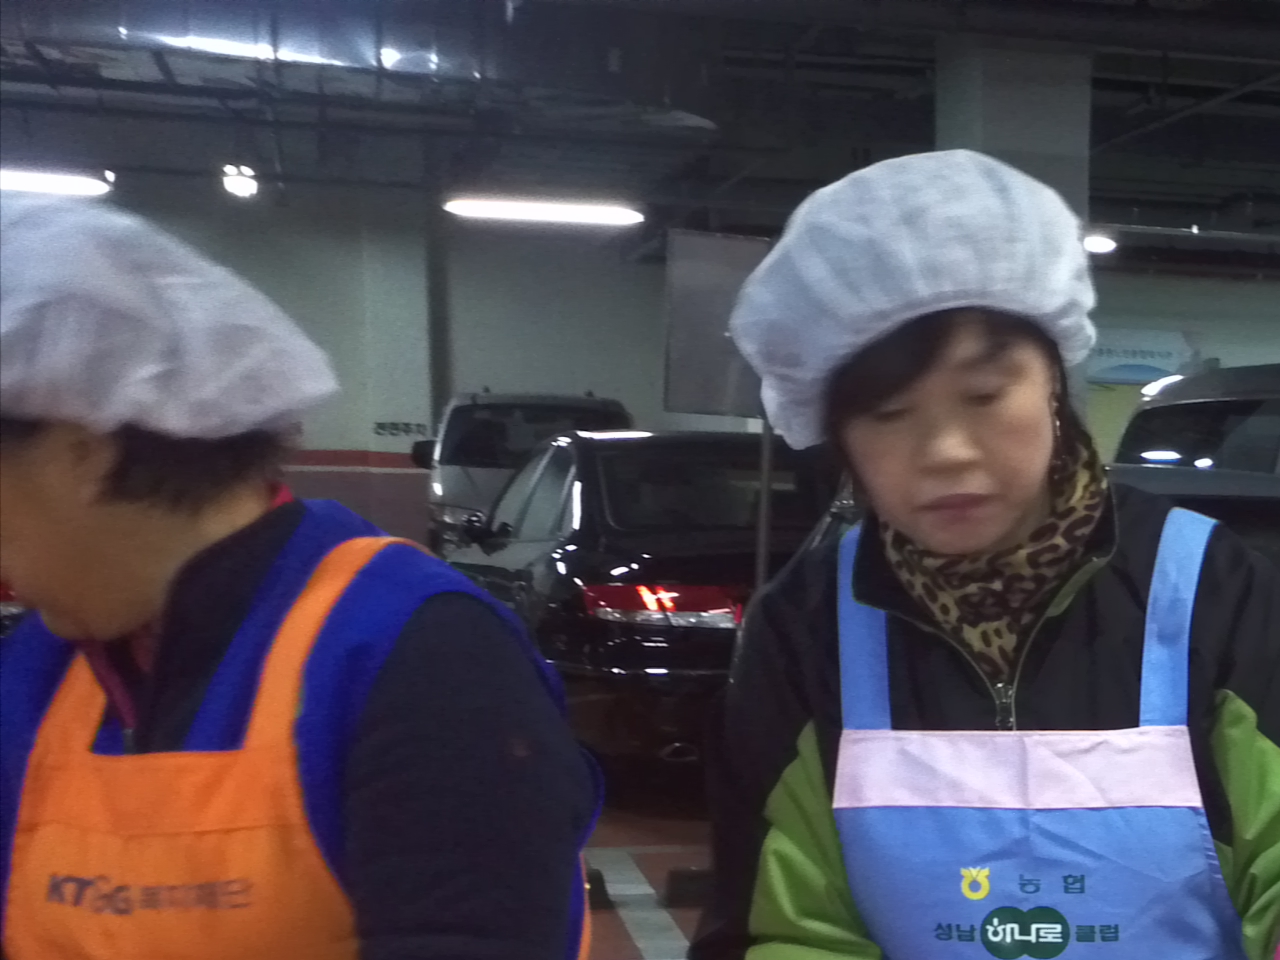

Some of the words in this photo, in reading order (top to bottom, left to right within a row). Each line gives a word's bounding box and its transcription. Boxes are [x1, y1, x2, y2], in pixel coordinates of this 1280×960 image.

[934, 922, 977, 943] 성남
[985, 916, 1064, 944] 하나로
[1075, 923, 1120, 943] 클럽
